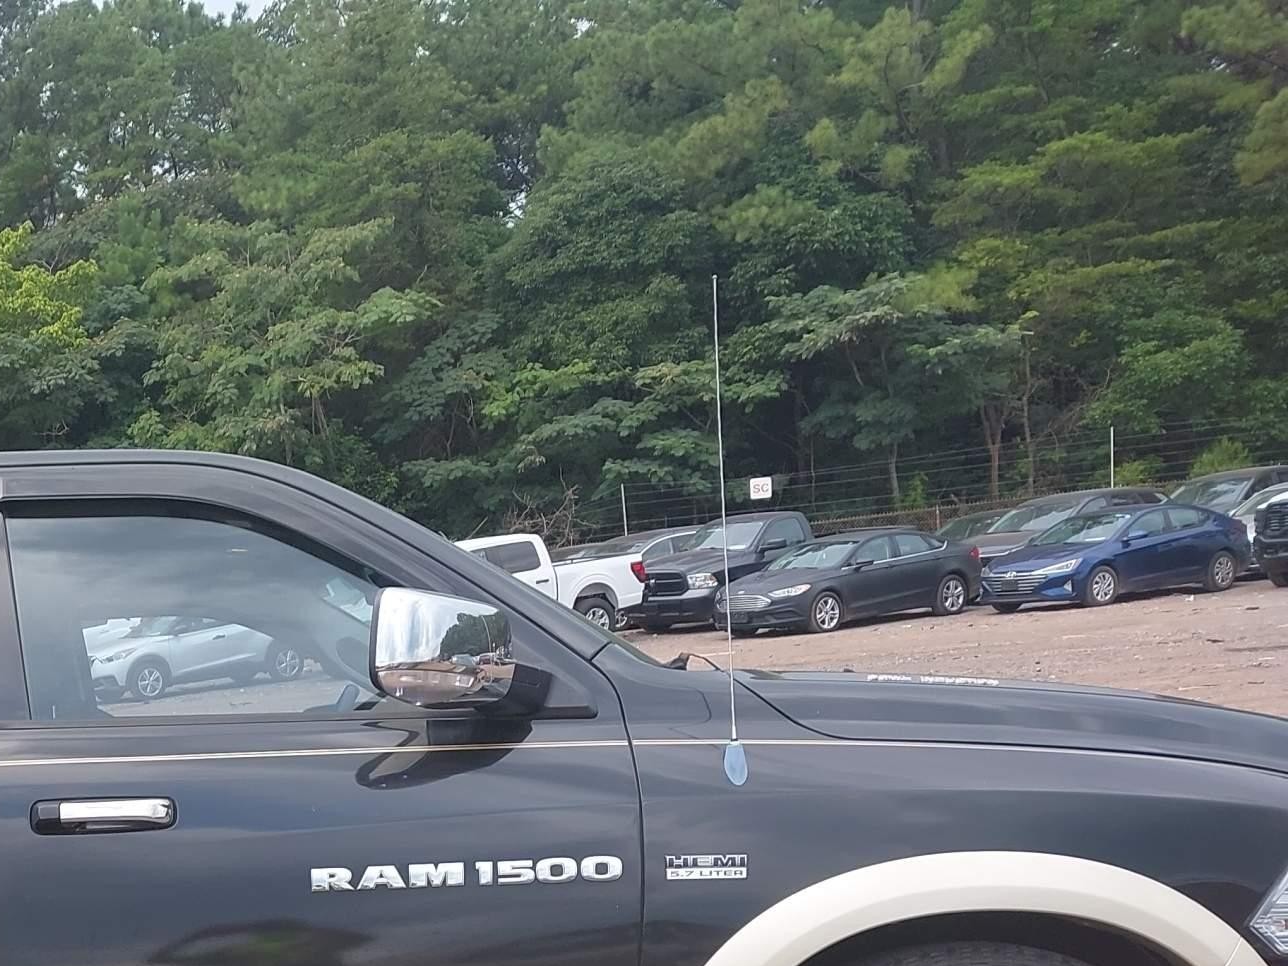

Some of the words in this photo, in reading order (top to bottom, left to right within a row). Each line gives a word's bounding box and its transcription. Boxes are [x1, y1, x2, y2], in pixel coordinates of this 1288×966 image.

[665, 854, 747, 868] HEMI
[311, 862, 465, 892] RAM
[475, 855, 623, 885] 1500
[670, 869, 694, 878] 5.7
[699, 869, 744, 877] LITER
